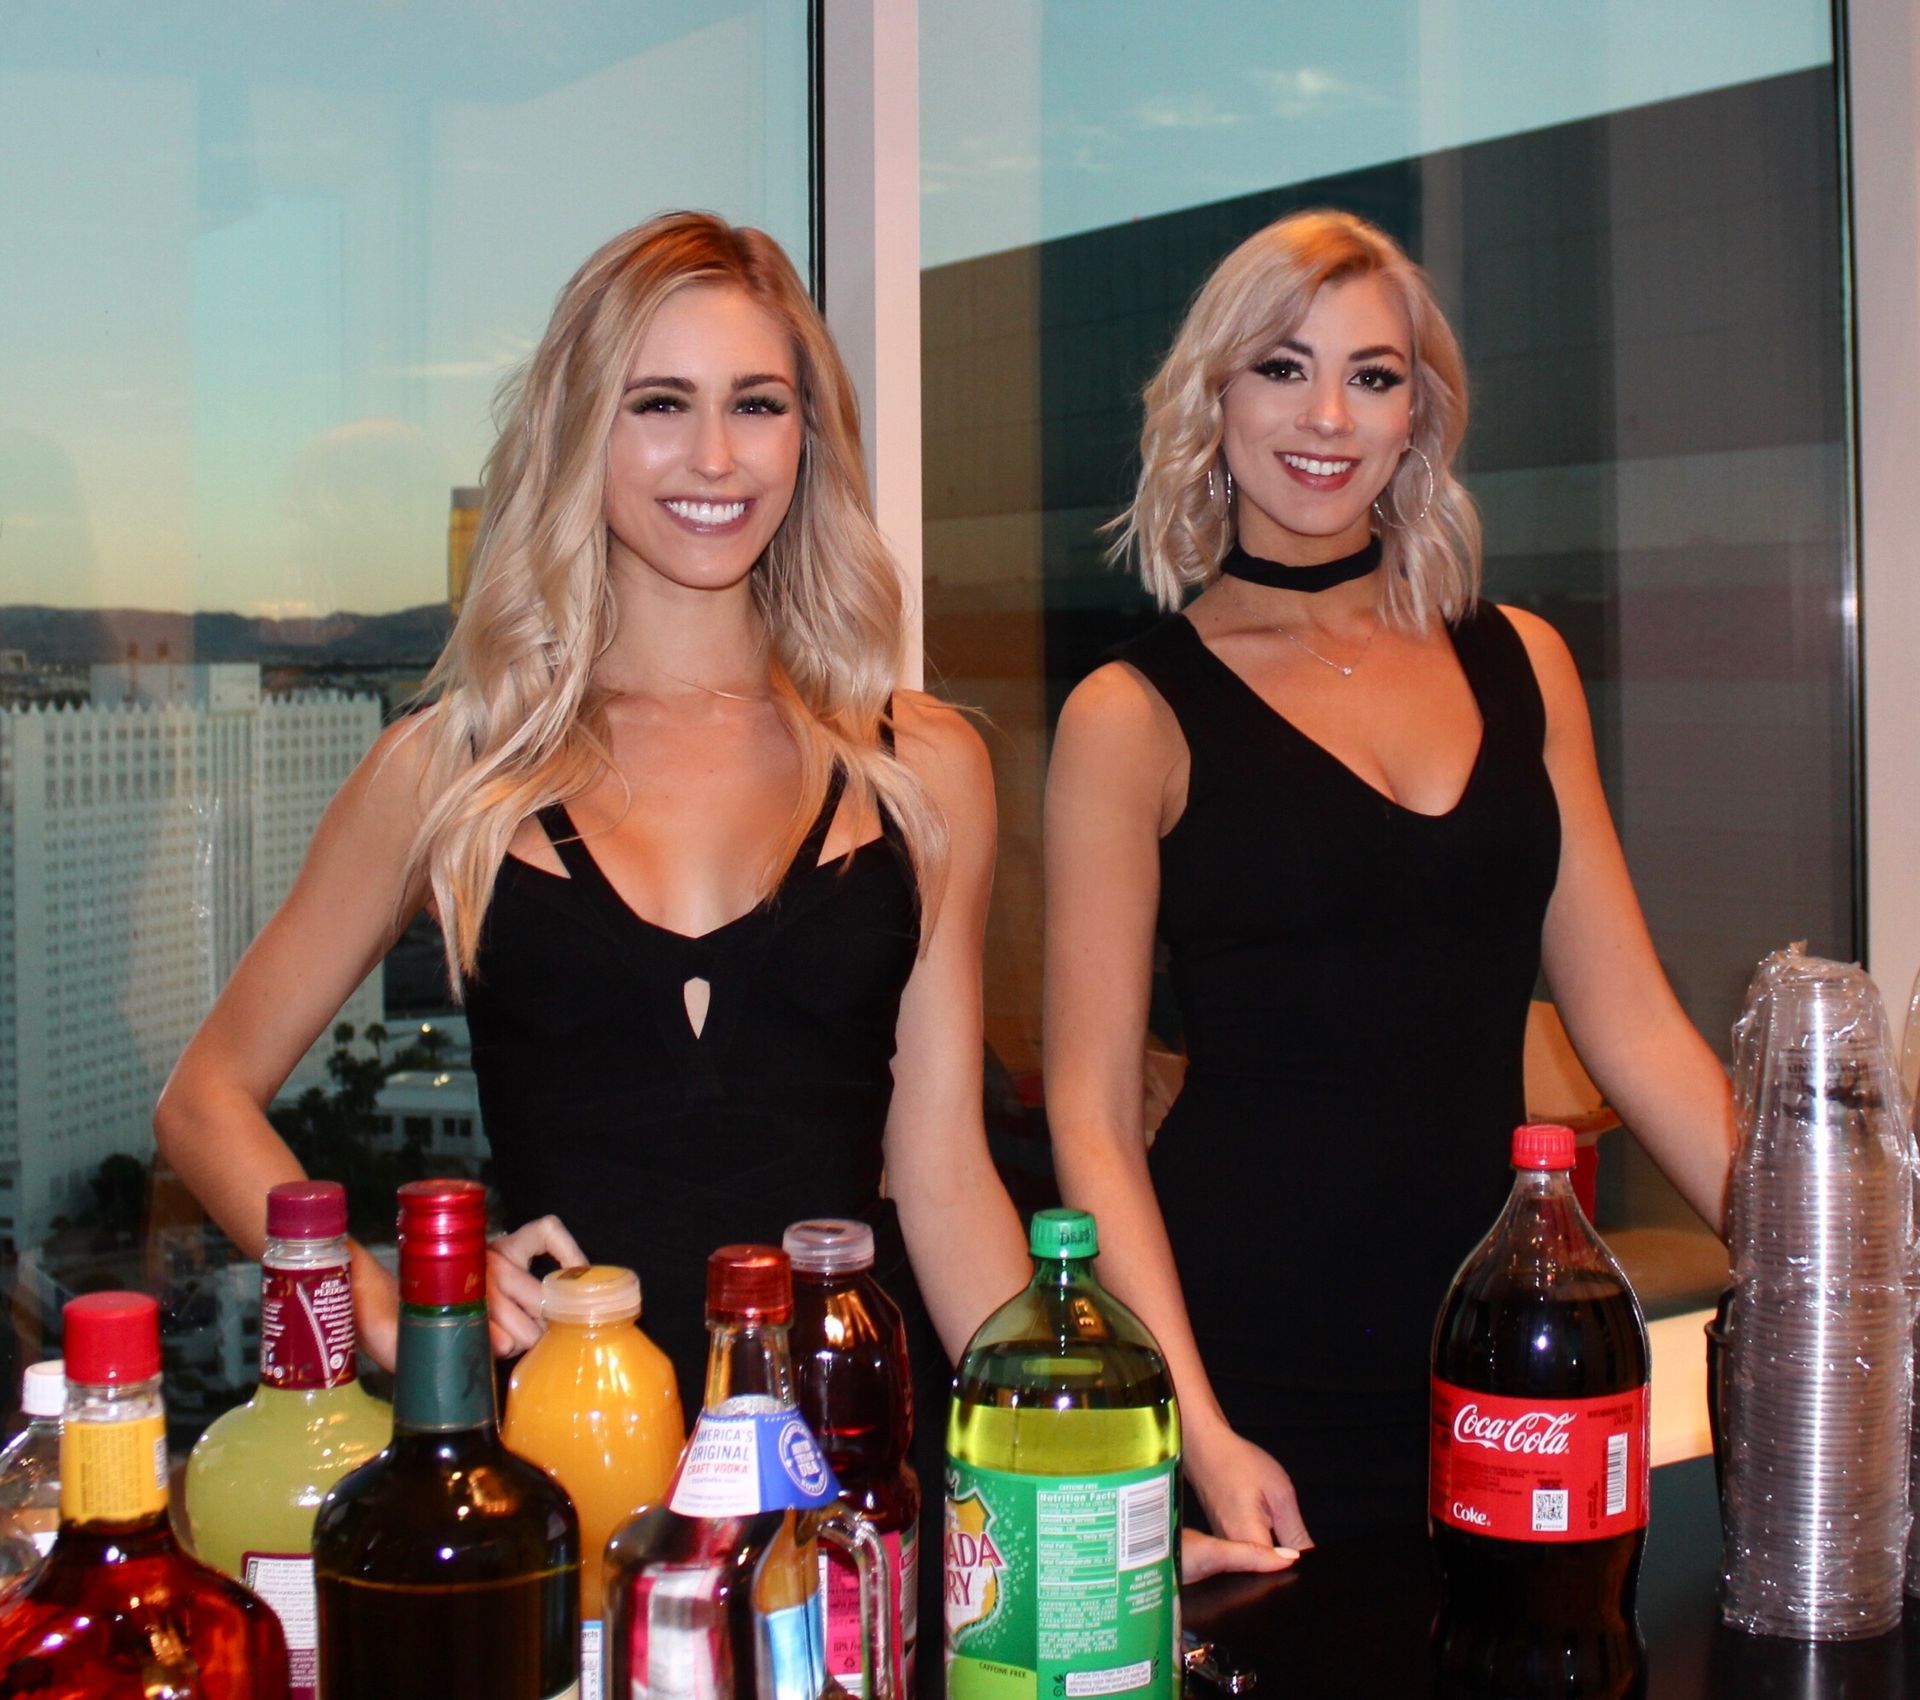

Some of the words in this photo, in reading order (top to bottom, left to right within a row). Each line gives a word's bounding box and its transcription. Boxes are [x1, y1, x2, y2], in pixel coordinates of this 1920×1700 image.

[697, 1428, 754, 1443] AMERICA'S
[1454, 1404, 1577, 1454] Coca-Cola
[691, 1445, 750, 1462] ORIGINAL
[687, 1463, 711, 1476] CRAFT
[715, 1463, 748, 1474] VODKA
[1040, 1493, 1086, 1502] Nutrition
[1090, 1491, 1116, 1501] Facts
[1453, 1502, 1487, 1526] Coke
[979, 1662, 1007, 1675] CAFFEINE
[1009, 1669, 1026, 1678] FREE
